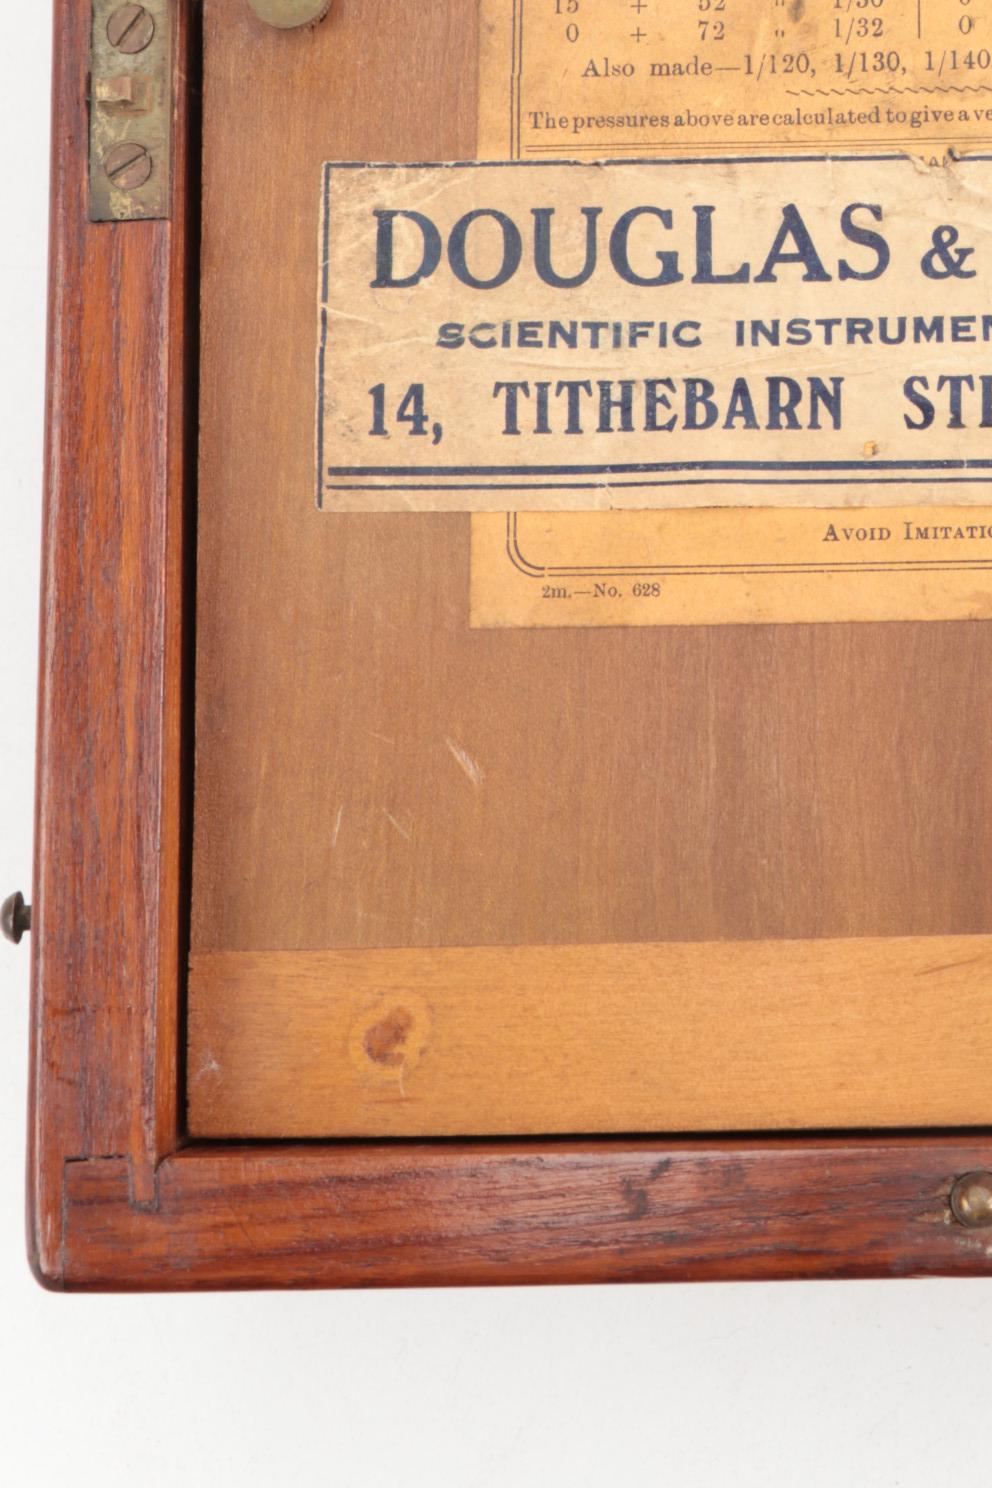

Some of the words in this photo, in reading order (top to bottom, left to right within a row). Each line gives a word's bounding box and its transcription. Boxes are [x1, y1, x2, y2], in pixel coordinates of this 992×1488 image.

[566, 23, 579, 43] 0
[698, 21, 725, 40] 72
[836, 18, 883, 45] 1/32
[959, 15, 974, 35] 0
[581, 57, 635, 77] Also
[835, 51, 906, 79] 1/130,
[529, 111, 568, 129] The
[573, 114, 670, 134] pressures
[674, 109, 733, 127] above
[738, 114, 769, 126] are
[773, 106, 881, 126] calculated
[886, 108, 906, 123] to
[910, 105, 954, 128] give
[958, 110, 969, 121] a
[369, 203, 890, 290] DOUGLAS
[921, 225, 976, 279] &
[436, 320, 701, 349] SCIENTIFIC
[368, 383, 442, 445] 14,
[493, 376, 844, 435] TITHEBARN
[632, 583, 660, 597] 628
